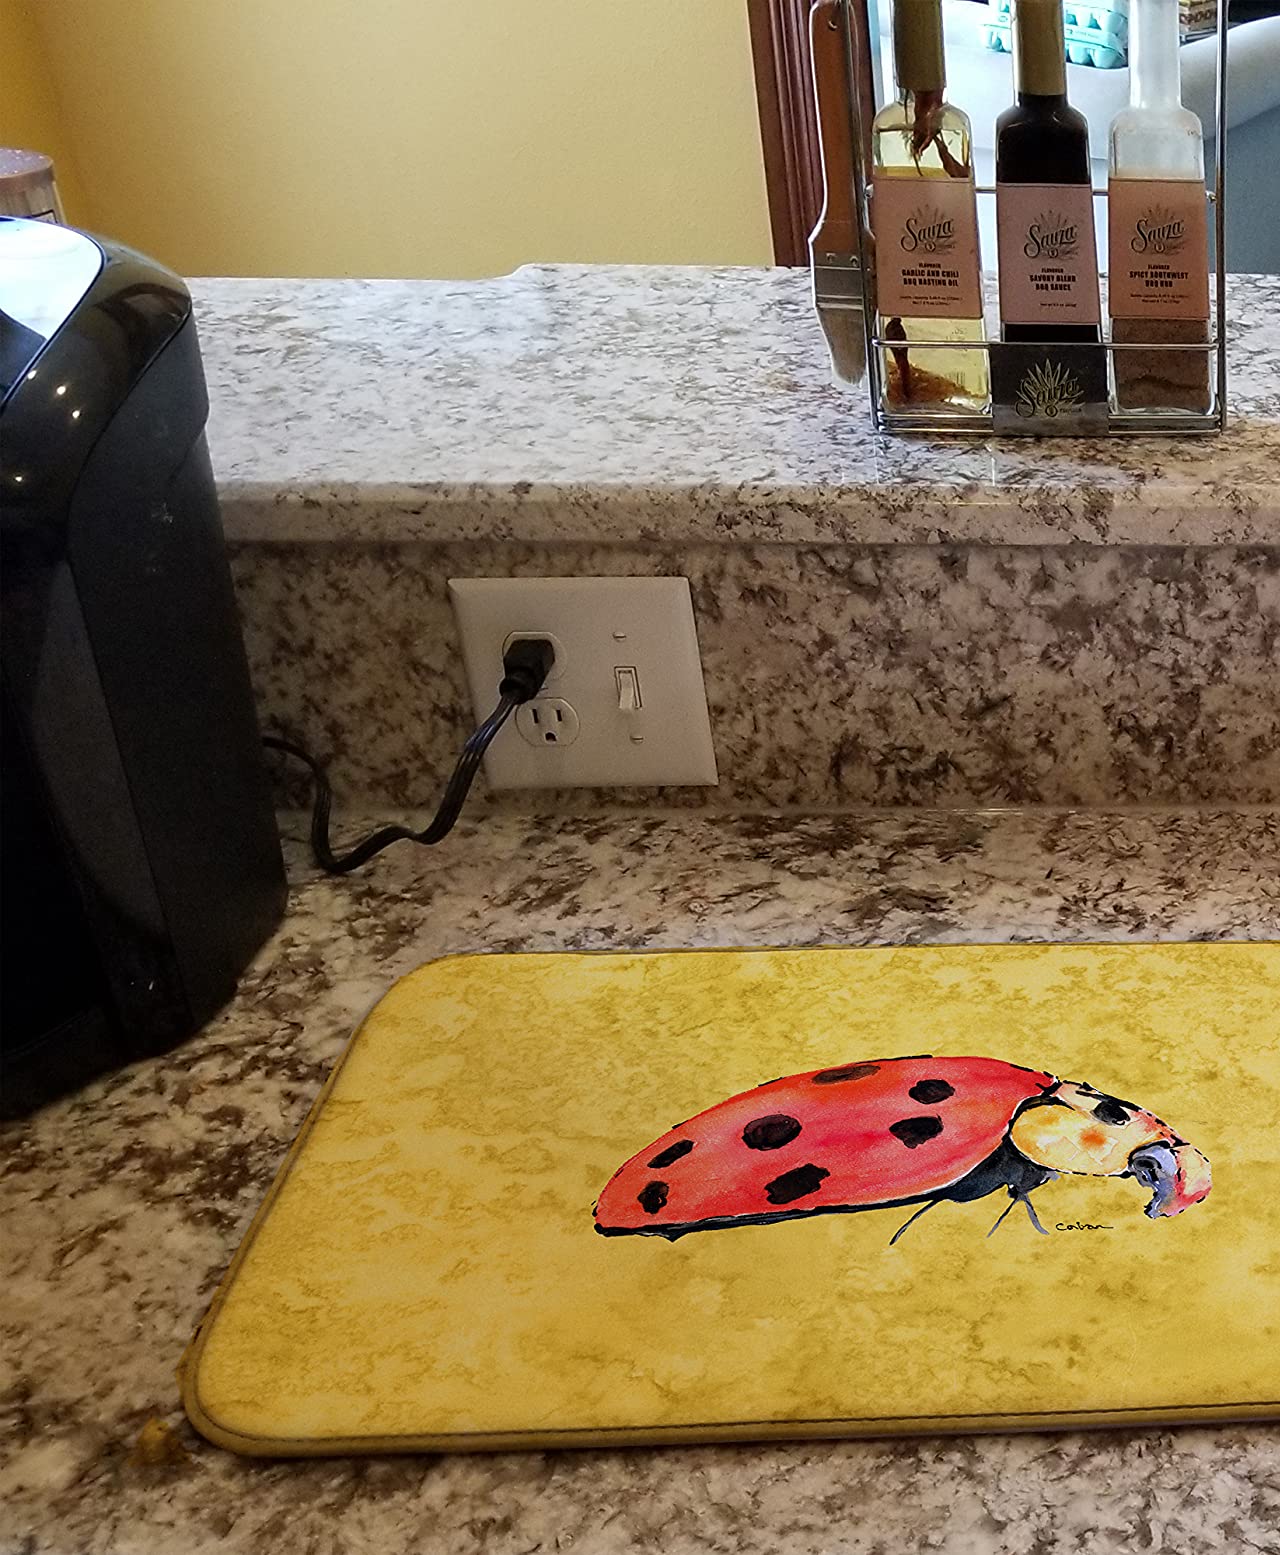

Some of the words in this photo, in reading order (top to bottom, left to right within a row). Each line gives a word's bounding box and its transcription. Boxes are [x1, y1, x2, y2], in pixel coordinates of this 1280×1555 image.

[901, 218, 954, 252] Sauza
[1024, 224, 1077, 258] Sauza
[1131, 219, 1184, 253] Sauza
[902, 269, 925, 277] GARLIC
[926, 269, 940, 277] AND
[948, 279, 959, 287] OIL
[1029, 274, 1055, 282] SAVORY
[1150, 271, 1189, 279] SOUTHWEST
[1015, 377, 1078, 418] Sauza
